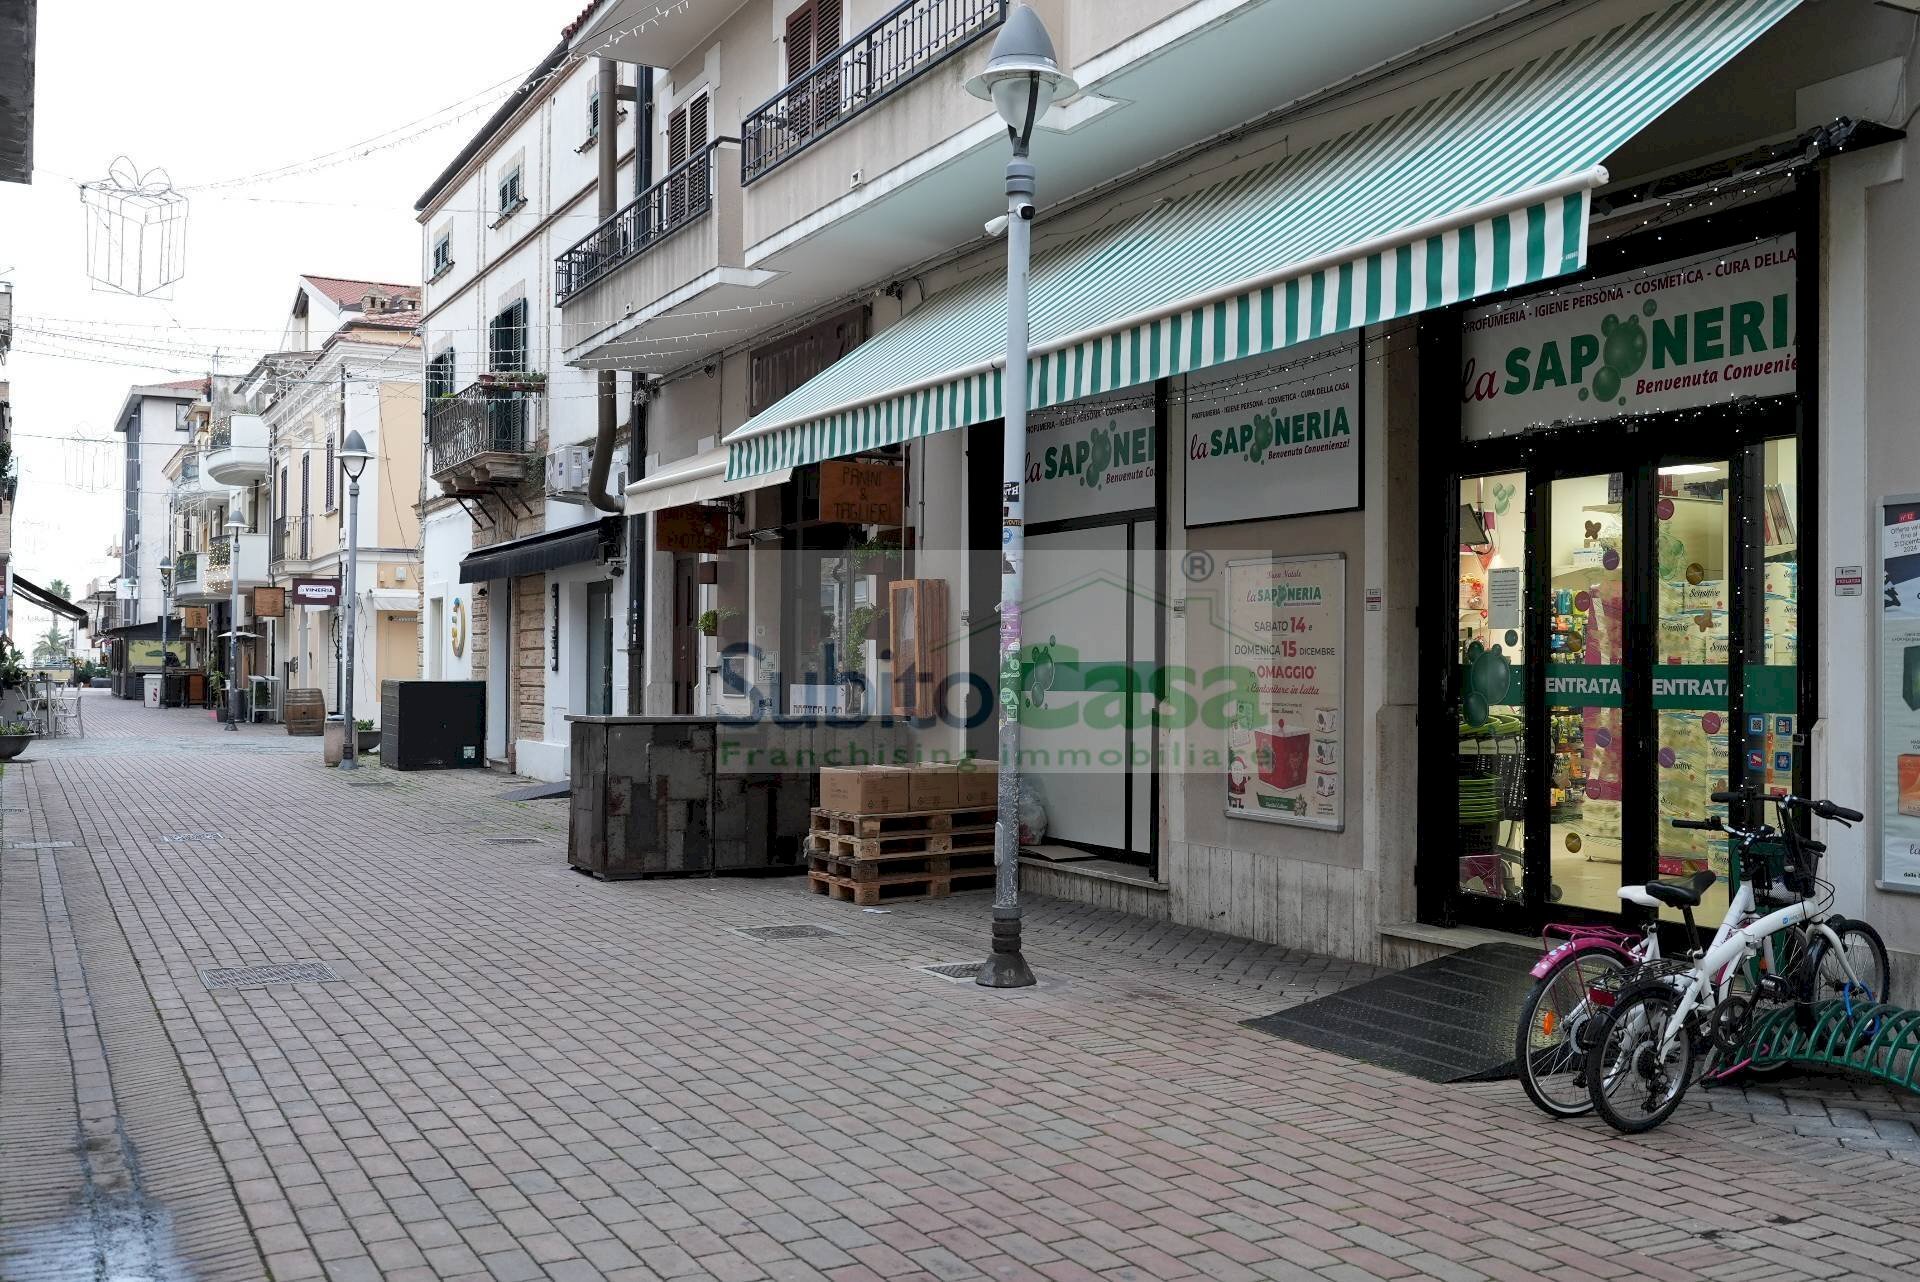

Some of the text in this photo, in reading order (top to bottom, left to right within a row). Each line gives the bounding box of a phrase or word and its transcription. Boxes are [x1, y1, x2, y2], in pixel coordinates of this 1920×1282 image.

[1464, 310, 1526, 334] PROFUMERIA
[1535, 302, 1570, 318] IGIENE
[1573, 288, 1624, 310] PERSONA
[1633, 269, 1704, 296] COSMETICA
[1715, 258, 1750, 278] CURA
[1754, 248, 1796, 269] DELLA
[1462, 292, 1796, 404] la SAPONERI
[1635, 369, 1718, 396] Benvenuta
[1191, 408, 1221, 420] PROFUMERIA
[1240, 399, 1264, 411] PERSONA
[1267, 393, 1297, 405] COSMETICA
[1300, 389, 1316, 399] CURA
[1316, 385, 1334, 396] DELLA
[1334, 382, 1350, 392] CASA
[1190, 406, 1351, 461] la SAPONERIA
[1267, 438, 1351, 460] Benvenuta Convenienza!
[842, 466, 882, 488] PANINI
[1105, 470, 1144, 485] Benvenuta
[832, 502, 892, 522] TAGLIERI
[1257, 585, 1322, 603] SAPONERIA
[1689, 585, 1721, 599] Sensitive
[1254, 620, 1289, 632] SABATO
[1290, 616, 1306, 633] 14
[1234, 640, 1336, 658] DOMENICA 15 DICEMBRE
[1545, 677, 1622, 695] ENTRATA
